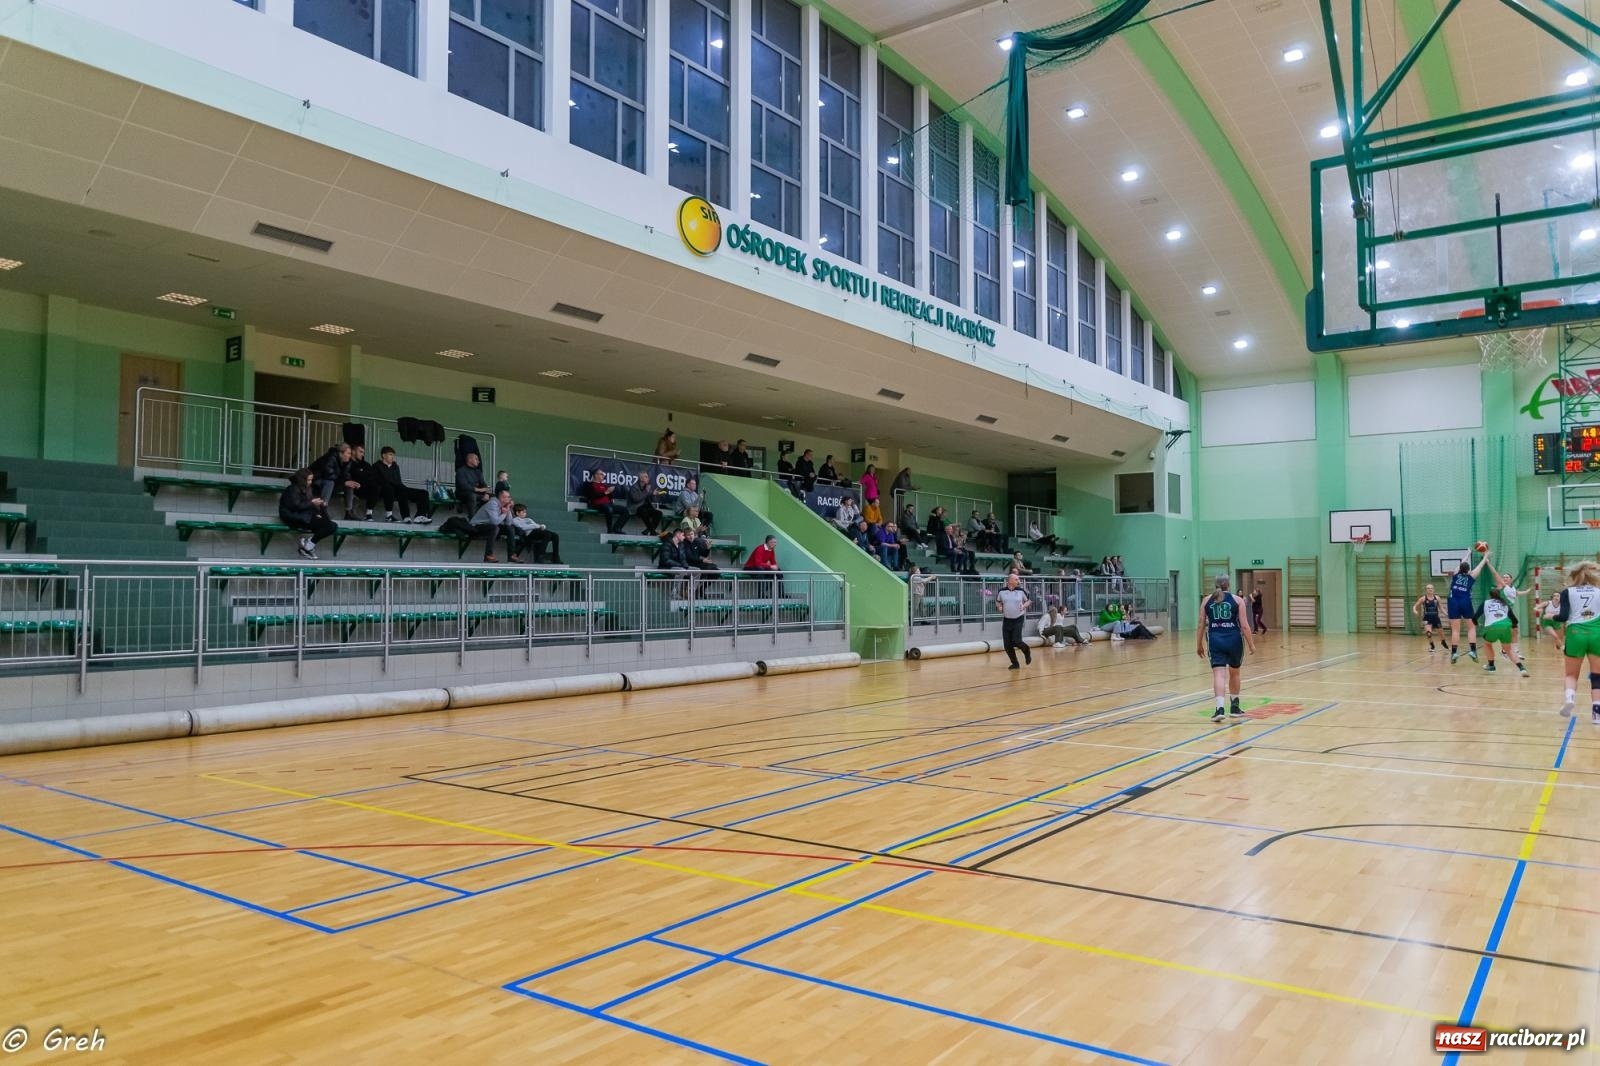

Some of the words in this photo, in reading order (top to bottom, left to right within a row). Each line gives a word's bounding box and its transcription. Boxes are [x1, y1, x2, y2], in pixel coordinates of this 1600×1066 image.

[726, 223, 808, 275] OŚRODEK
[812, 257, 870, 298] SPORTU
[872, 281, 878, 302] I
[881, 286, 943, 328] REKREACJI
[946, 311, 996, 347] RACIBÓRZ
[230, 345, 239, 359] E
[478, 392, 489, 401] E
[855, 453, 862, 461] F
[582, 470, 639, 487] RCIBÓRZ
[817, 496, 843, 507] RACIBÓ
[1580, 594, 1594, 608] 7
[1209, 601, 1232, 620] 18
